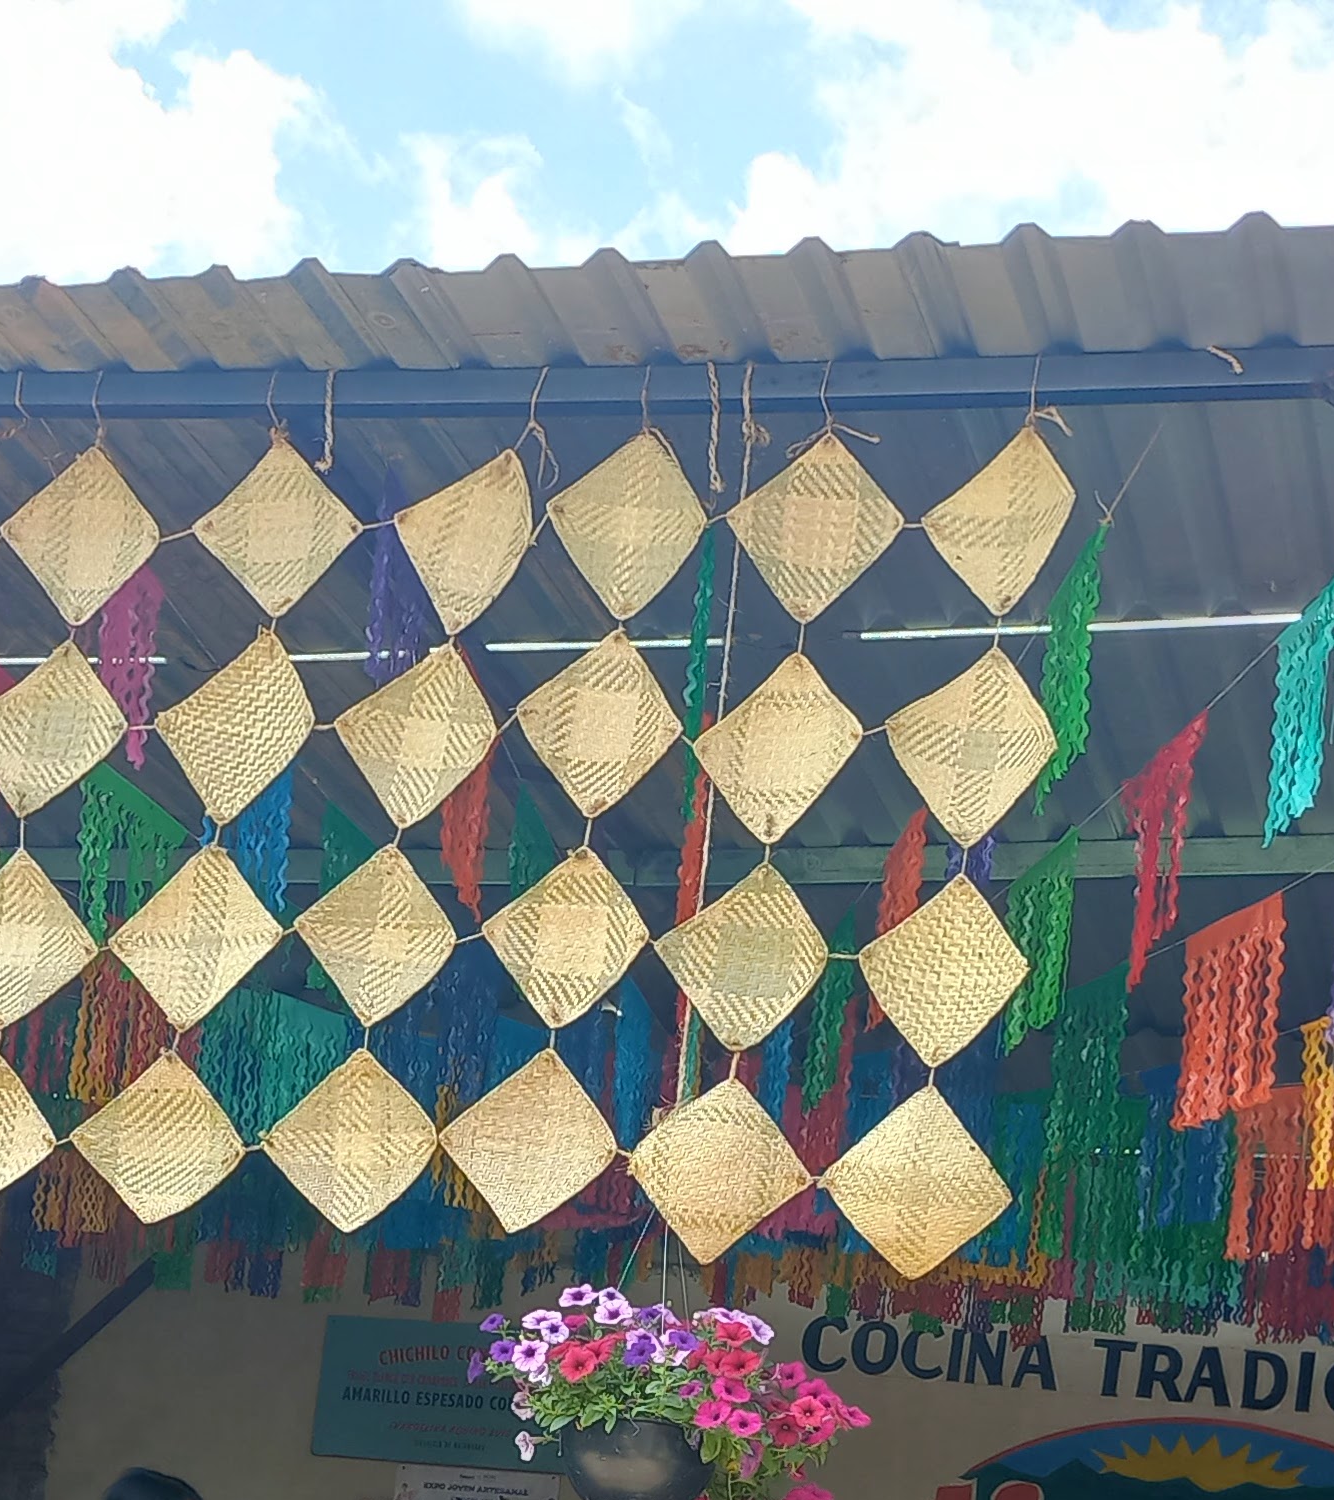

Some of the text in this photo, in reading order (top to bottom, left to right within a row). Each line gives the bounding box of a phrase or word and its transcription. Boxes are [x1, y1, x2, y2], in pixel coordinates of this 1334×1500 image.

[378, 1345, 450, 1366] CHICHILO
[801, 1315, 1058, 1391] COCINA
[342, 1386, 410, 1405] AMARILLO
[415, 1391, 484, 1410] ESPESADO
